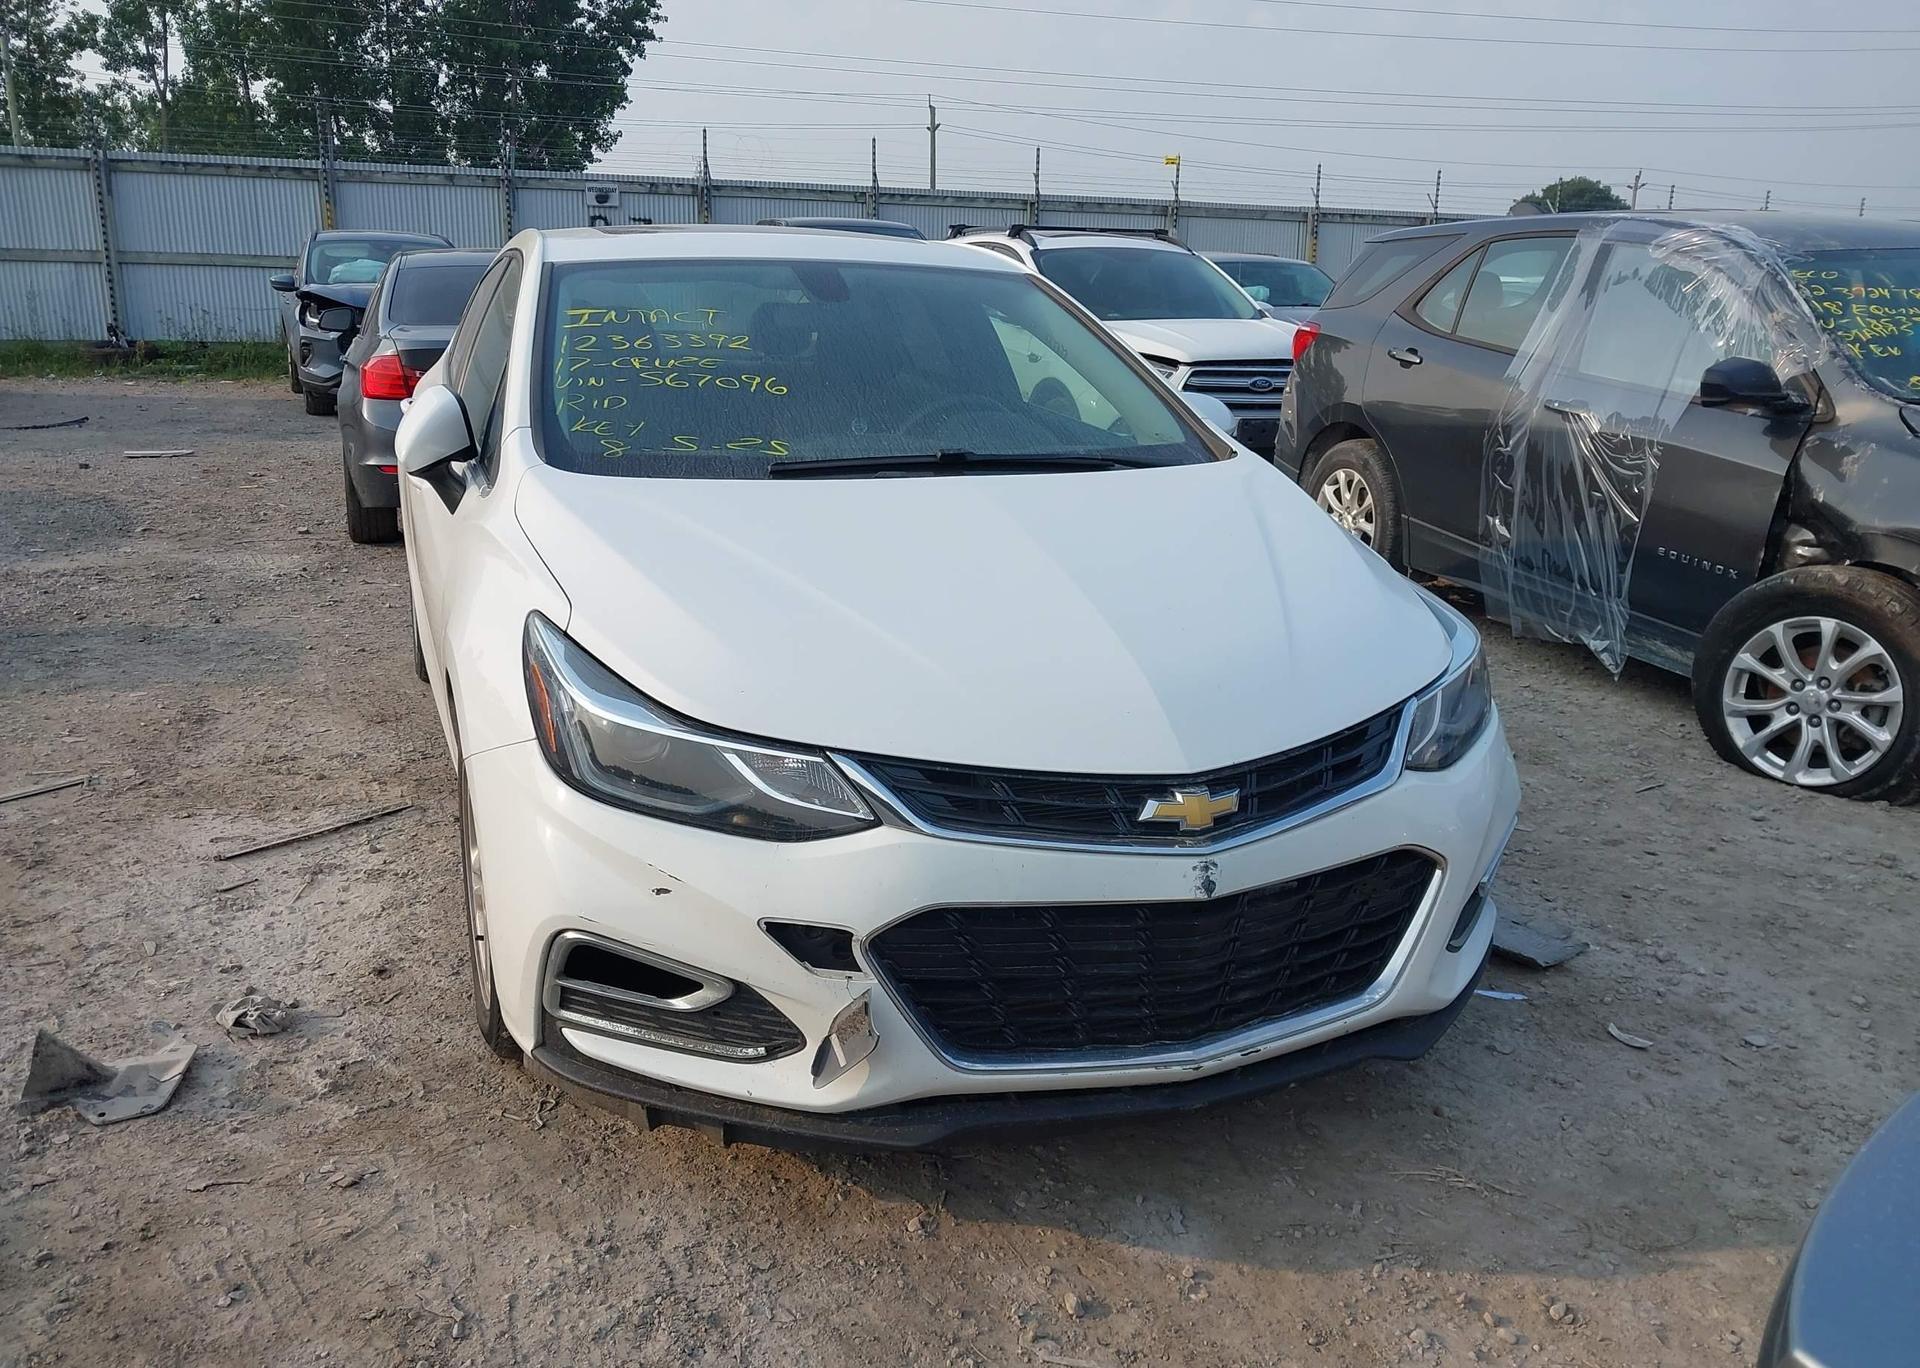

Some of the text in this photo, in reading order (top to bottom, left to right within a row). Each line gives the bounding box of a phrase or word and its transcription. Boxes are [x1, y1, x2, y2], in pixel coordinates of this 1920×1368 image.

[587, 186, 617, 194] WEDNESDAY
[564, 309, 726, 328] INTACT
[561, 334, 753, 353] 12363392
[571, 415, 645, 437] KEY
[1657, 546, 1738, 580] EQUINOX
